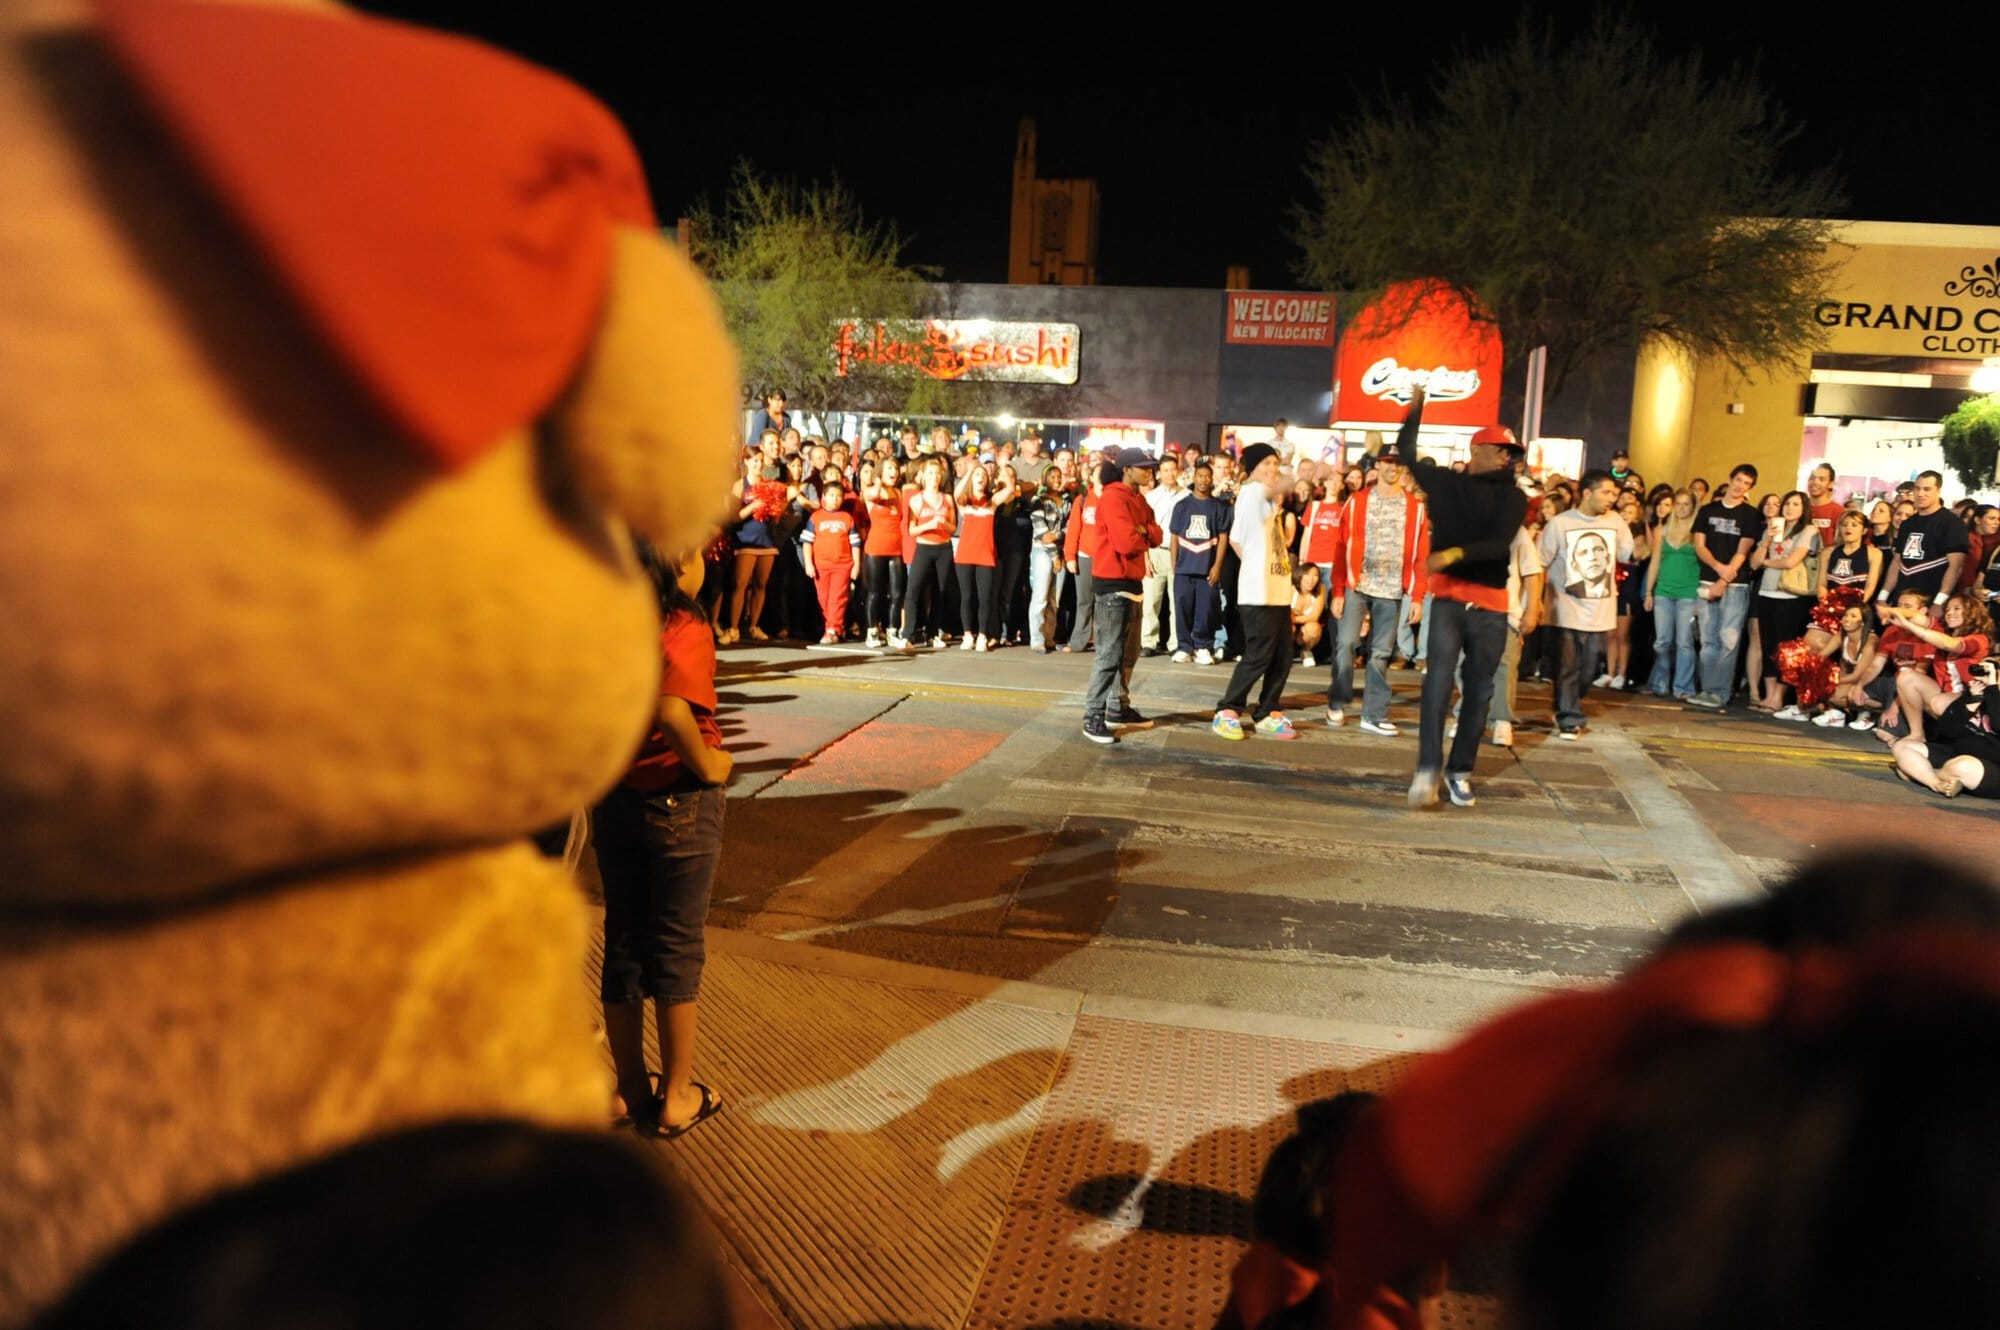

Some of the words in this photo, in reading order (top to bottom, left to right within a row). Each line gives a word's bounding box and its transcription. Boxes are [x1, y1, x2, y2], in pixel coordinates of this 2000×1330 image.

[1233, 298, 1330, 323] WELCOME
[1814, 301, 1963, 332] GRAND
[1233, 324, 1259, 339] NEW
[1264, 325, 1327, 341] WILDCATS!
[971, 328, 1071, 369] sushi
[1186, 514, 1210, 539] A
[1902, 532, 1925, 560] A
[1832, 558, 1854, 576] A
